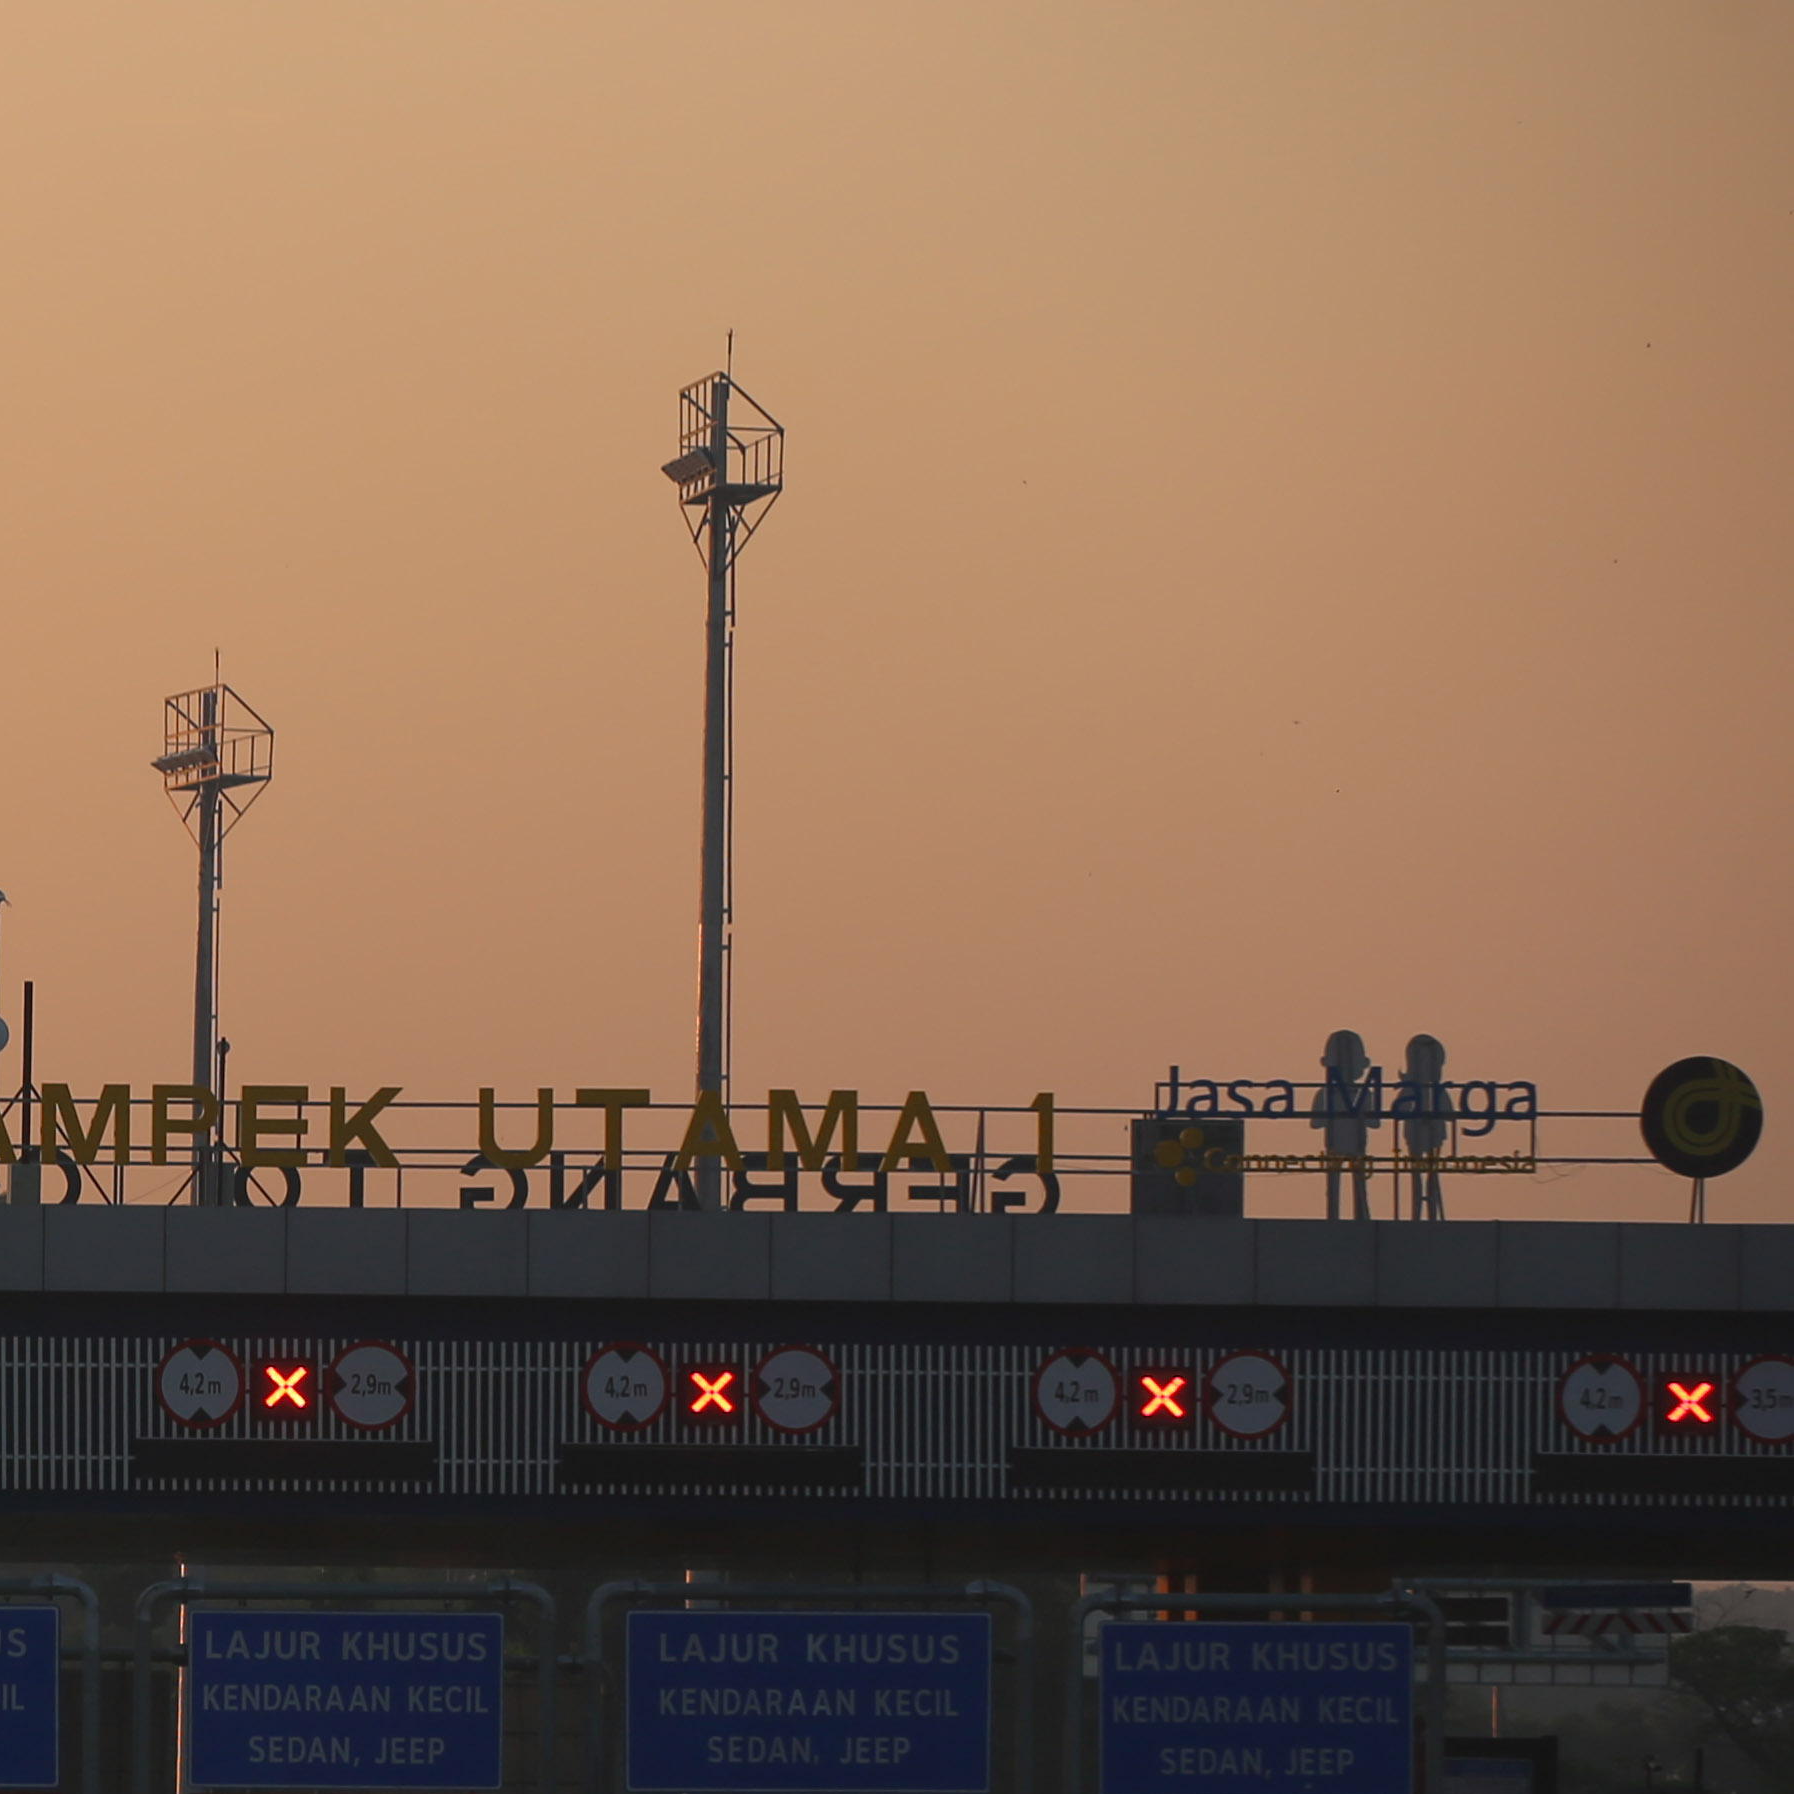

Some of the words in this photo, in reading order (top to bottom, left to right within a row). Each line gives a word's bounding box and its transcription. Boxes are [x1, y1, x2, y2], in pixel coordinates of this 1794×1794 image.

[1158, 1066, 1294, 1119] Jasa
[1327, 1066, 1537, 1137] Marga
[478, 1087, 958, 1173] UTAMA
[1028, 1092, 1055, 1174] 1
[206, 1631, 320, 1659] LAJUR
[342, 1632, 486, 1661] KHUSUS
[660, 1634, 778, 1662] LAJUR
[807, 1634, 958, 1664] KHUSUS
[1116, 1642, 1229, 1671] LAJUR
[1252, 1642, 1396, 1671] KHUSUS
[204, 1684, 390, 1712] KENDARAAN
[409, 1686, 488, 1712] KECIL
[660, 1688, 855, 1716] KENDARAAN
[876, 1689, 958, 1716] KECIL
[1114, 1696, 1299, 1722] KENDARAAN
[1319, 1696, 1398, 1723] KECIL
[249, 1736, 359, 1766] SEDAN,
[375, 1738, 444, 1764] JEEP
[840, 1737, 910, 1763] JEEP
[1161, 1748, 1271, 1778] SEDAN,
[1285, 1748, 1354, 1775] JEEP
